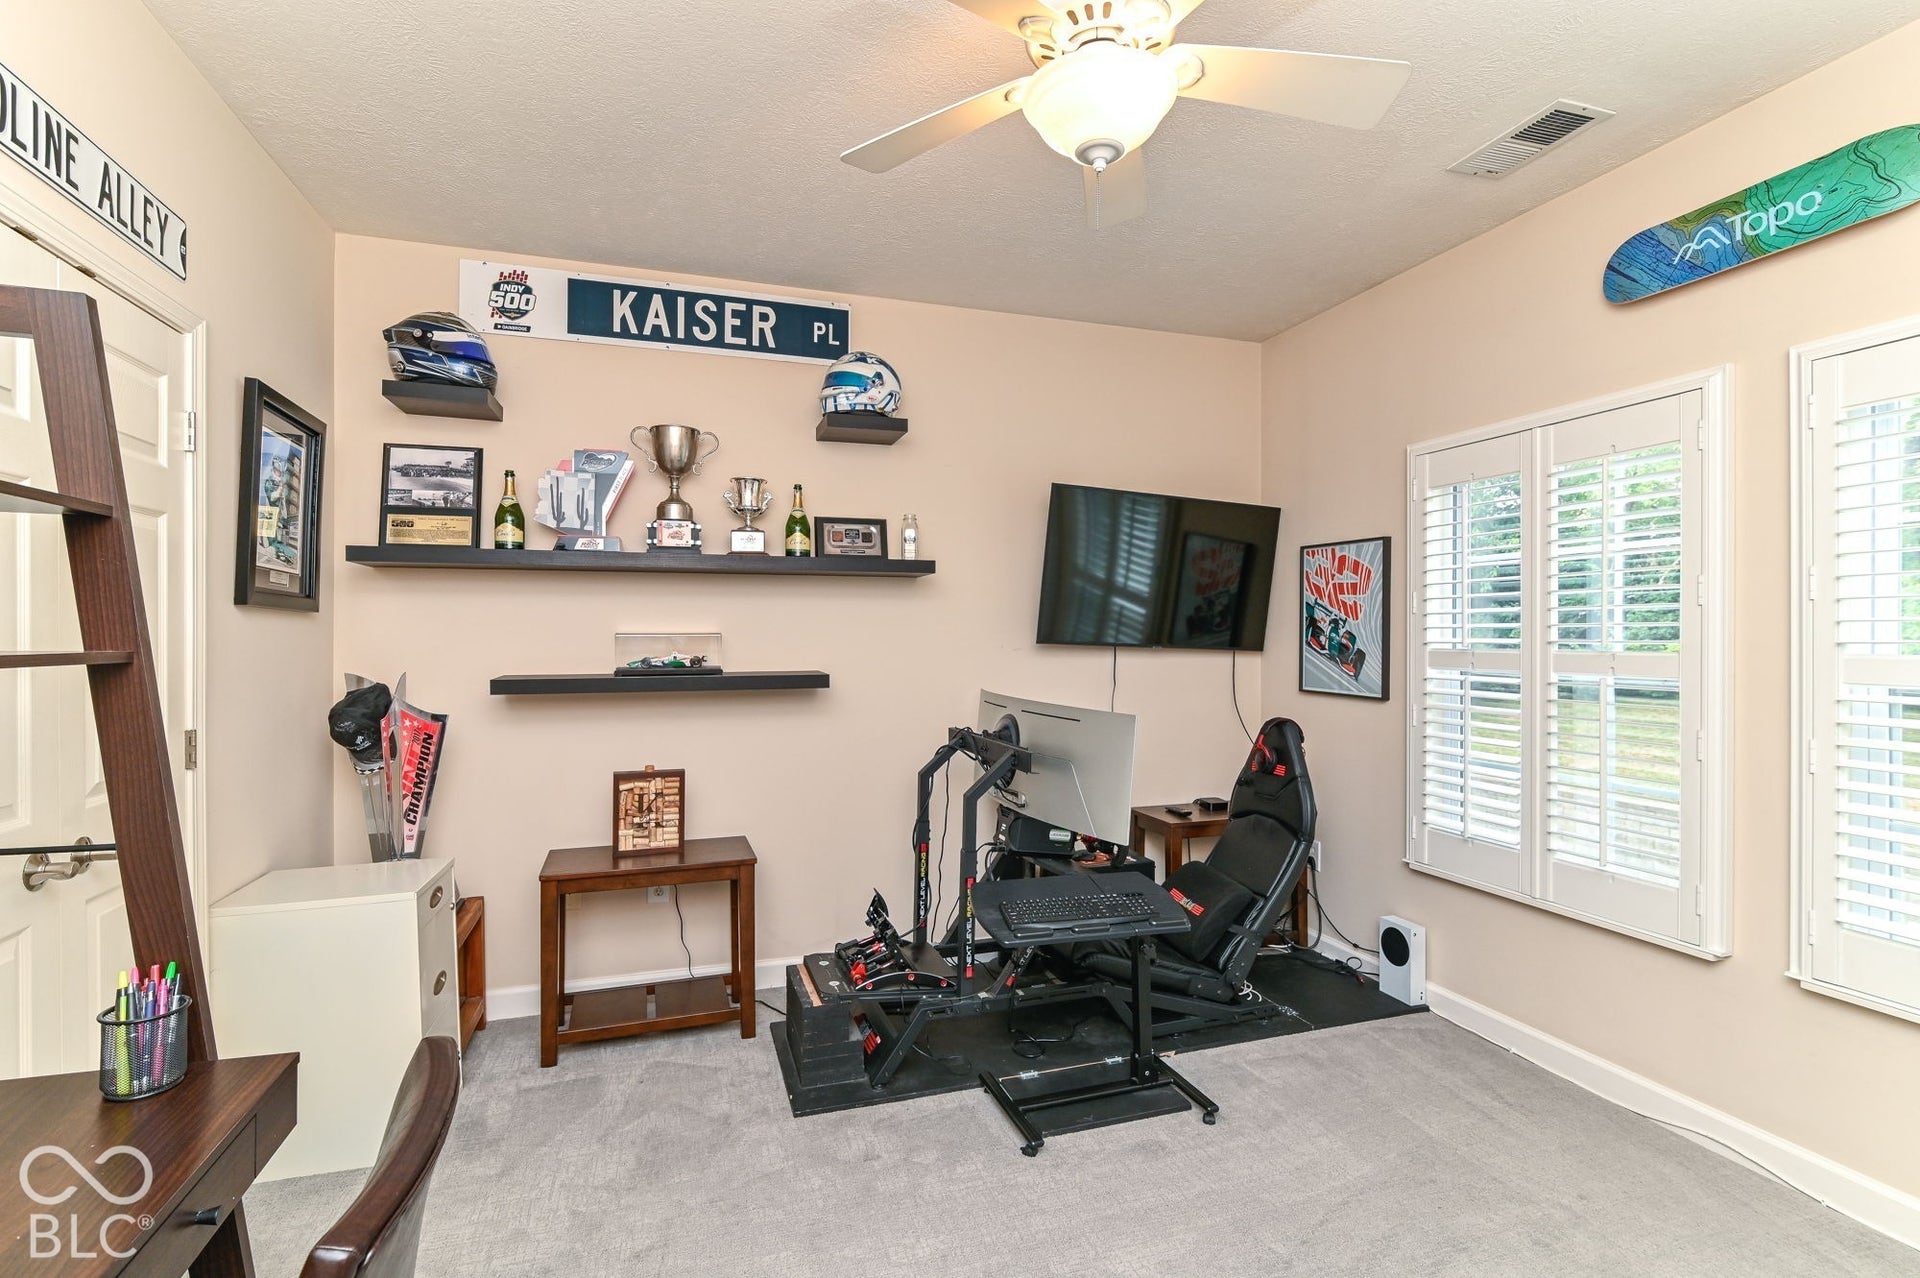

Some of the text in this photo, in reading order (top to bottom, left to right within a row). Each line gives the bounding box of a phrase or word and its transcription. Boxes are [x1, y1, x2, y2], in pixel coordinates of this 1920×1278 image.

[98, 161, 169, 257] ALLEY
[1725, 191, 1822, 241] Topo
[489, 290, 536, 311] 500
[499, 283, 525, 293] INDY
[612, 289, 840, 349] KAISER PL
[411, 728, 424, 744] 2017
[405, 731, 434, 826] CHAMPION
